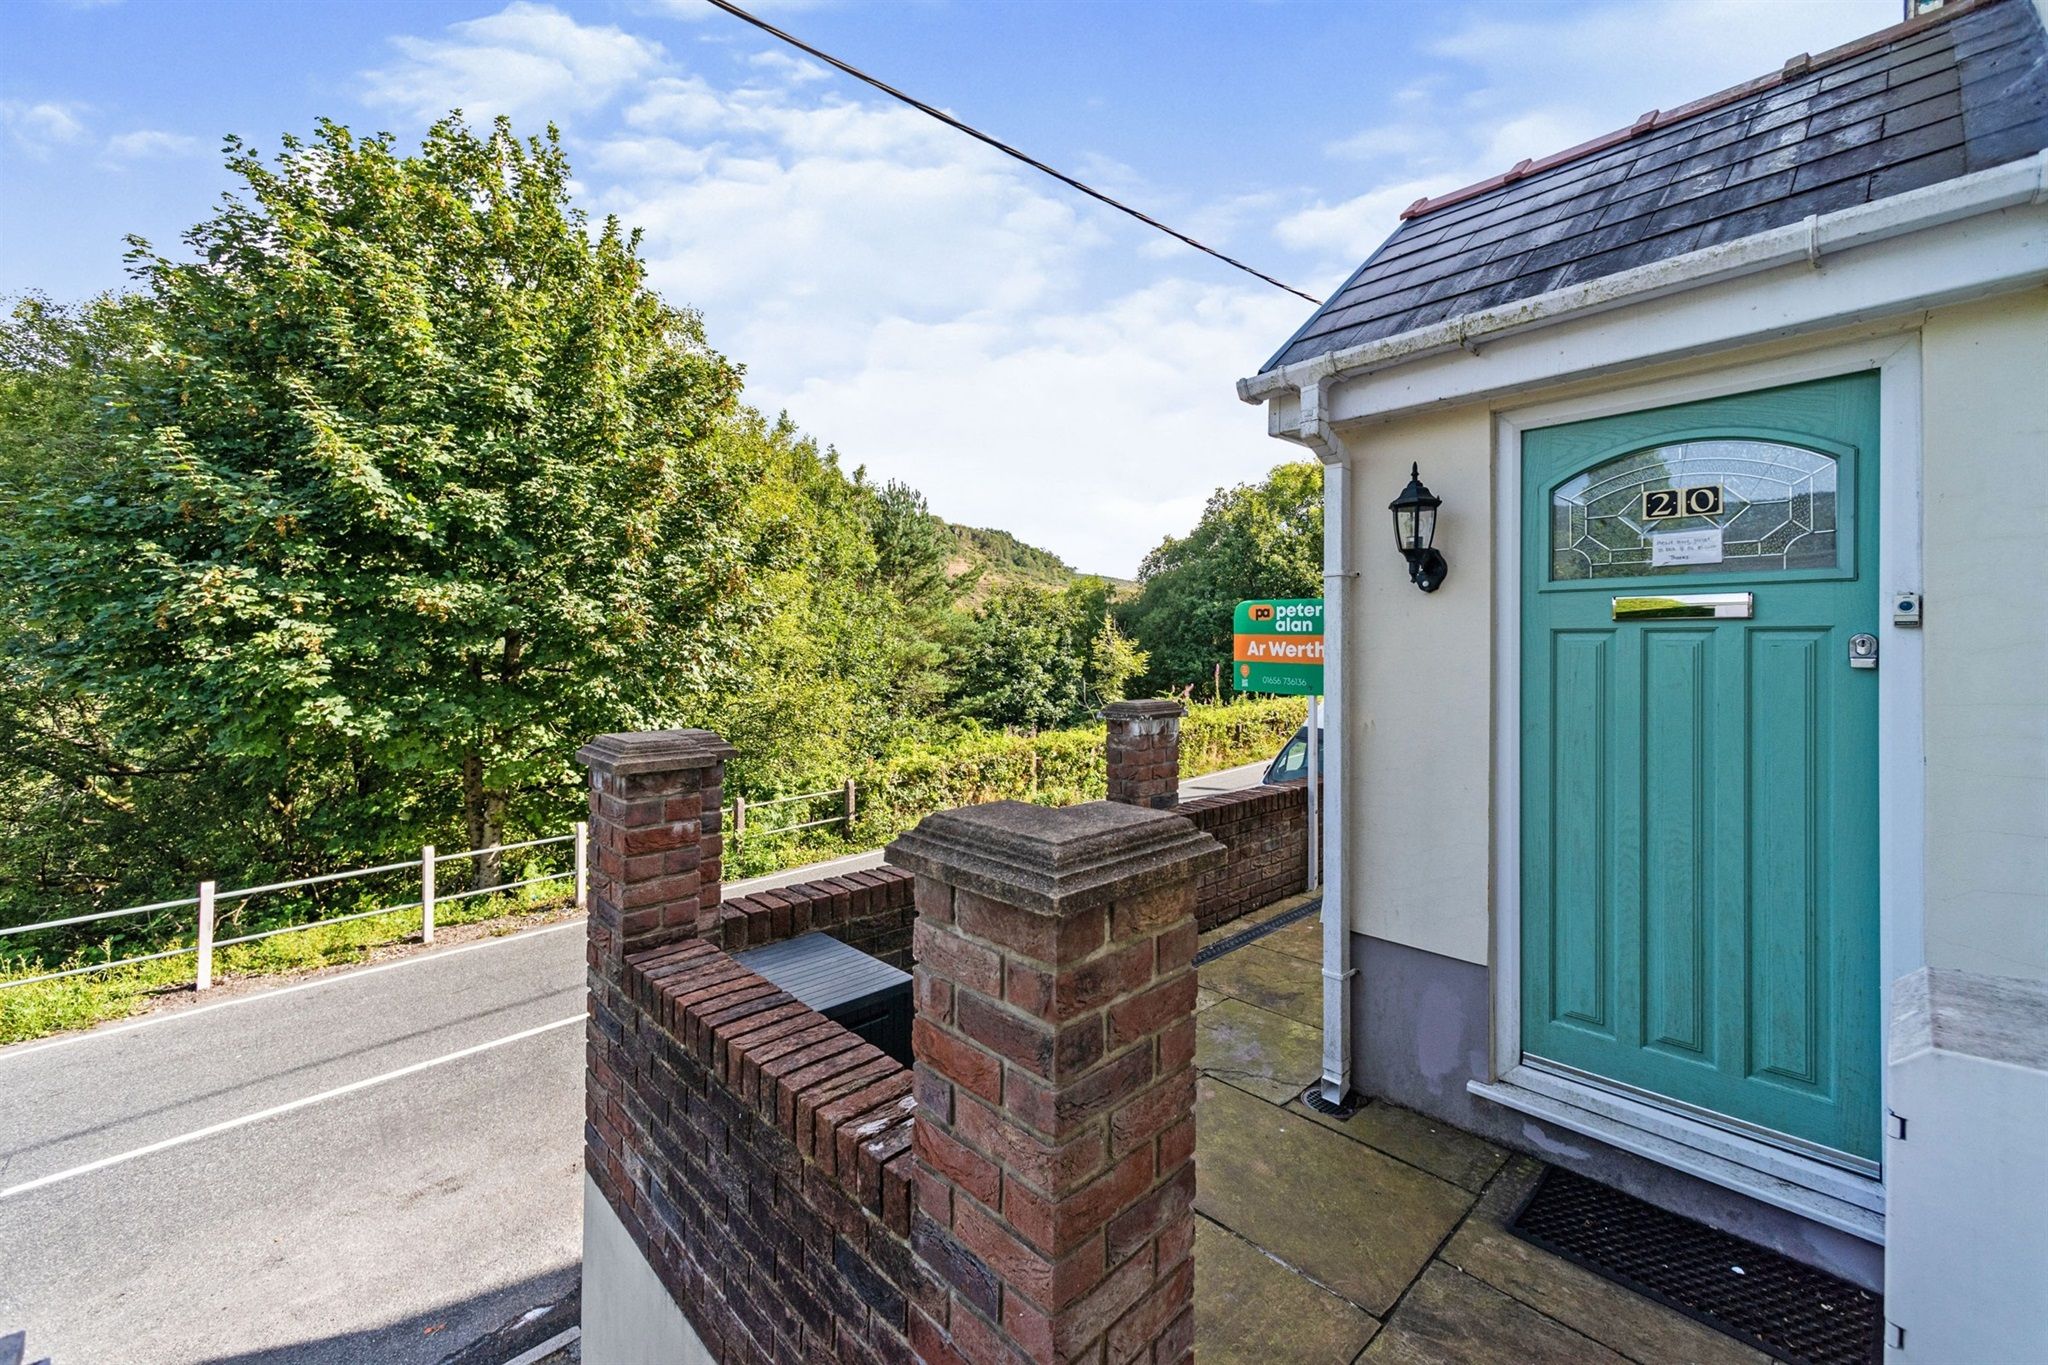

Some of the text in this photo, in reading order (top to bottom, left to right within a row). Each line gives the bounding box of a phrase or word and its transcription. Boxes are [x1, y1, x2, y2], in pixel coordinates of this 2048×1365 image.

[1651, 489, 1714, 516] 20
[1255, 608, 1270, 621] pa
[1276, 603, 1322, 620] peter
[1275, 618, 1312, 632] alan
[1247, 641, 1324, 658] Ar Werth
[1262, 675, 1306, 686] 01656 736136
